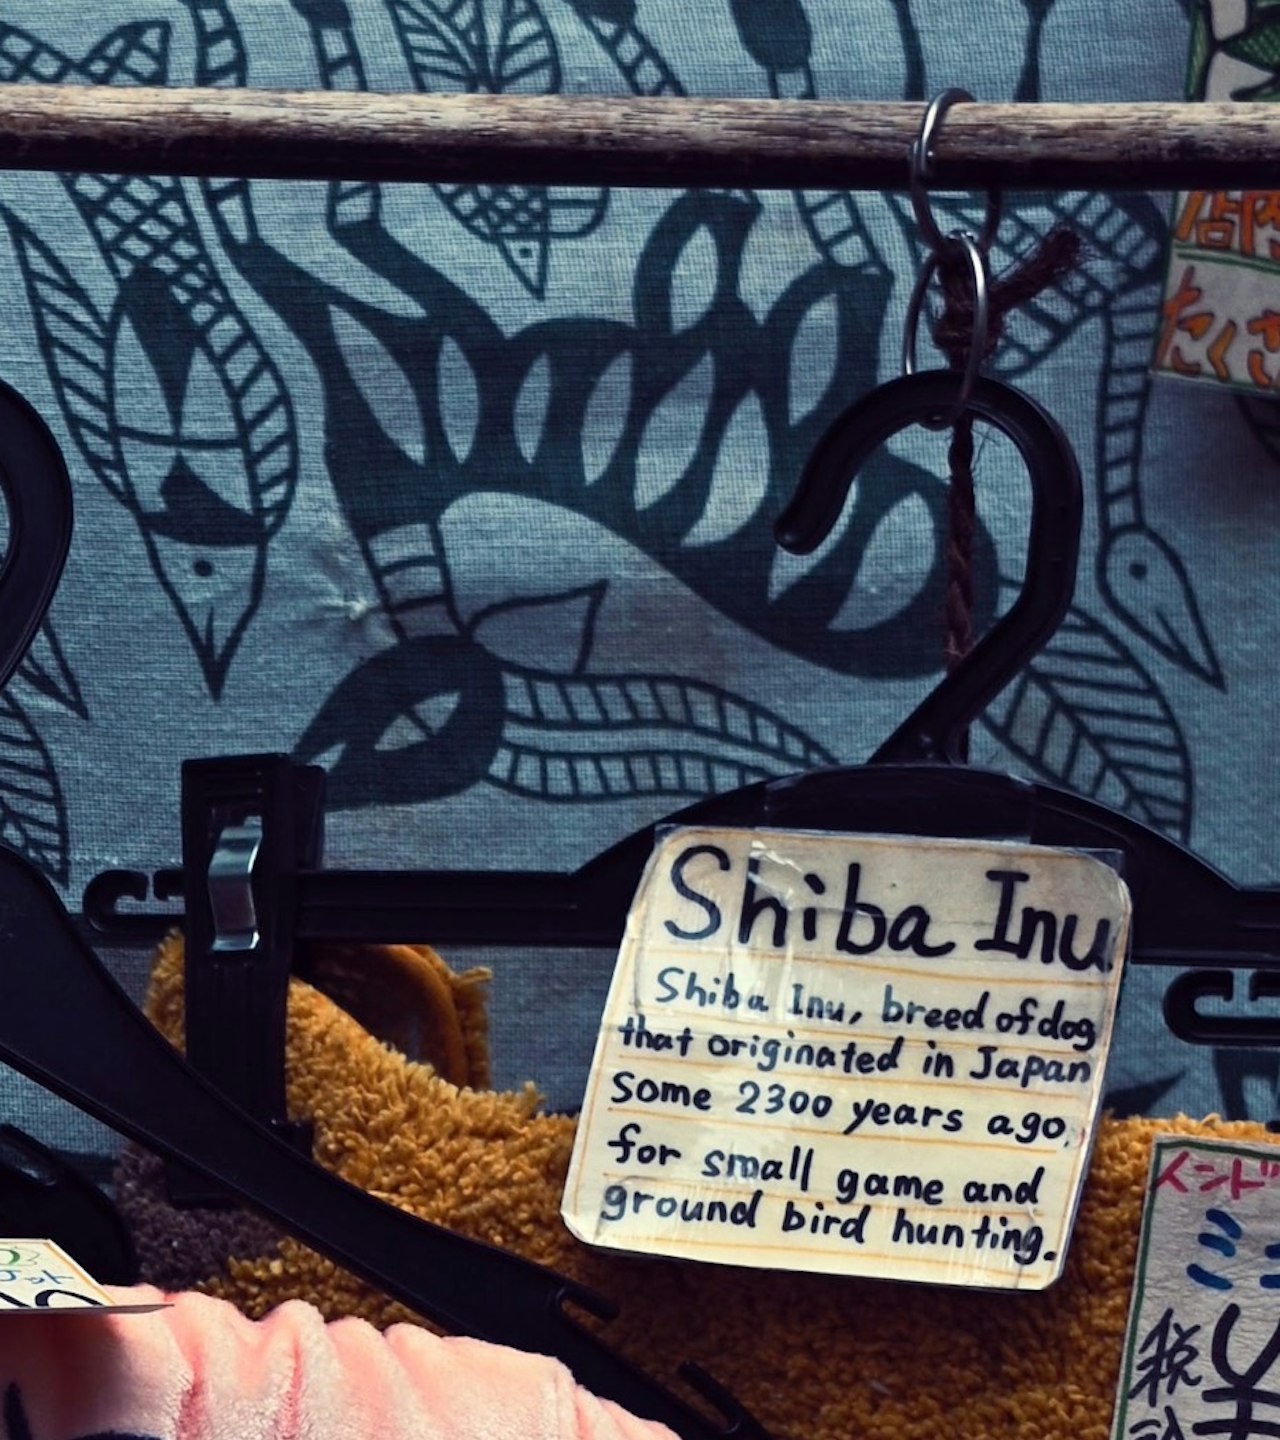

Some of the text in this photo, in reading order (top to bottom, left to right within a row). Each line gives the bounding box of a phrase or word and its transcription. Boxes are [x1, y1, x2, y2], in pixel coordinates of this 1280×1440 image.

[664, 845, 1113, 972] Shiba Inu
[655, 966, 1096, 1051] Shiba Inu, breed of dog
[618, 1015, 1091, 1088] that originated in Japan
[735, 1080, 834, 1118] 2300
[842, 1099, 964, 1136] years
[607, 1123, 1045, 1206] for small game and
[1154, 1150, 1280, 1201] インド
[600, 1185, 1057, 1266] ground bird hunting.
